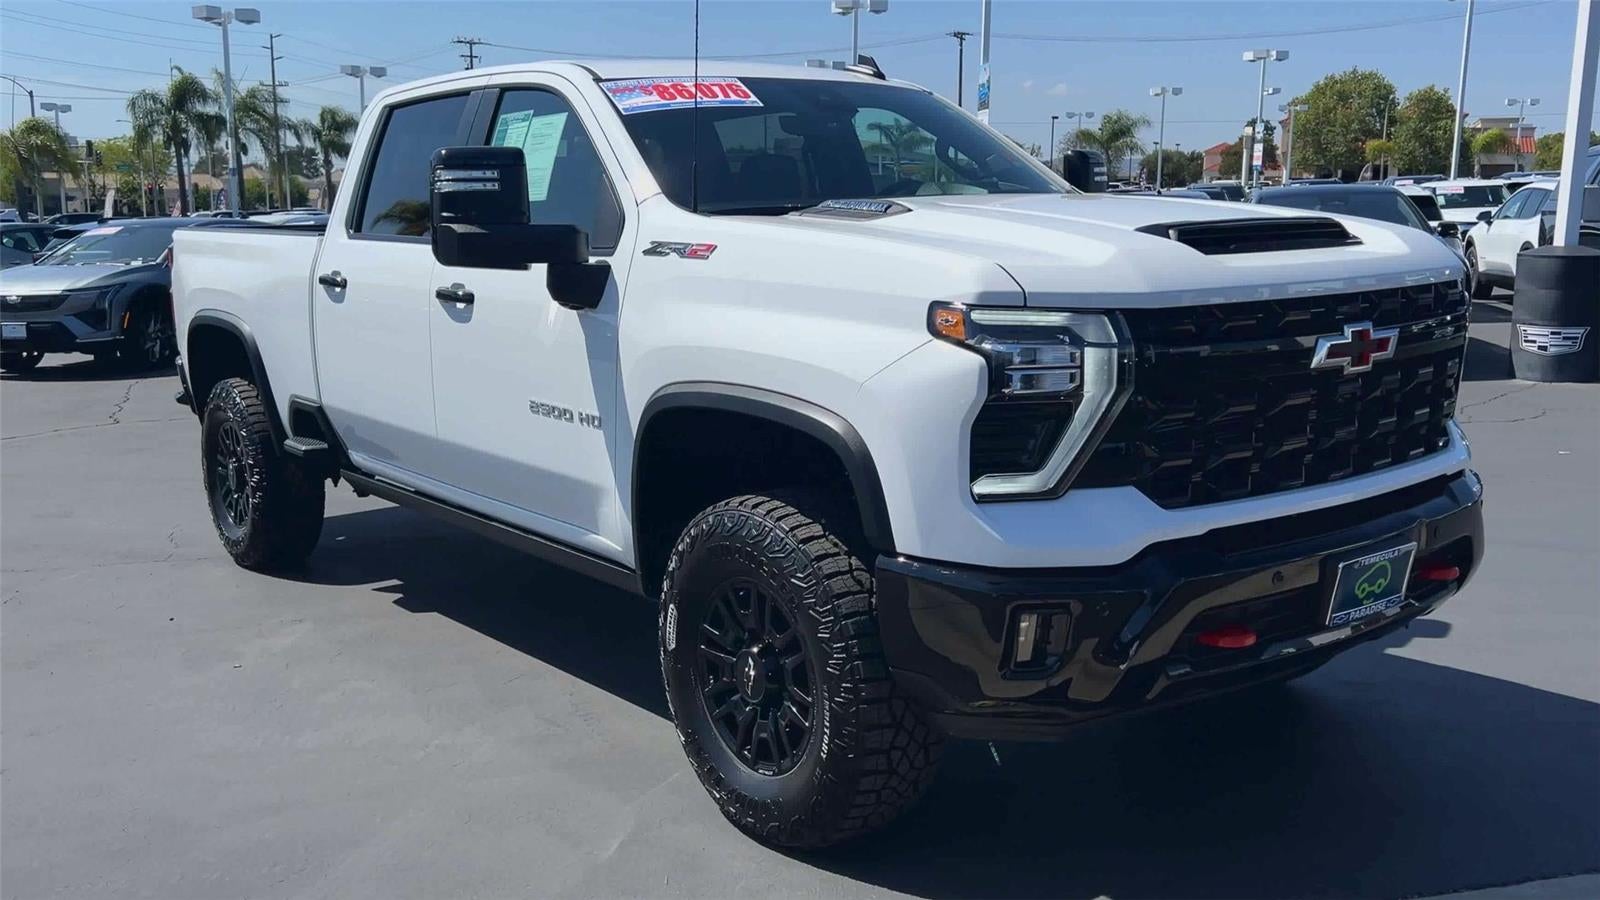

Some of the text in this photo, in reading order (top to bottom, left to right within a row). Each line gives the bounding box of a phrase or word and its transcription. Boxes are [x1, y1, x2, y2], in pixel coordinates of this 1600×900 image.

[642, 240, 718, 260] ZR2
[528, 399, 602, 431] 2500 HD
[1350, 601, 1387, 620] PARADISE
